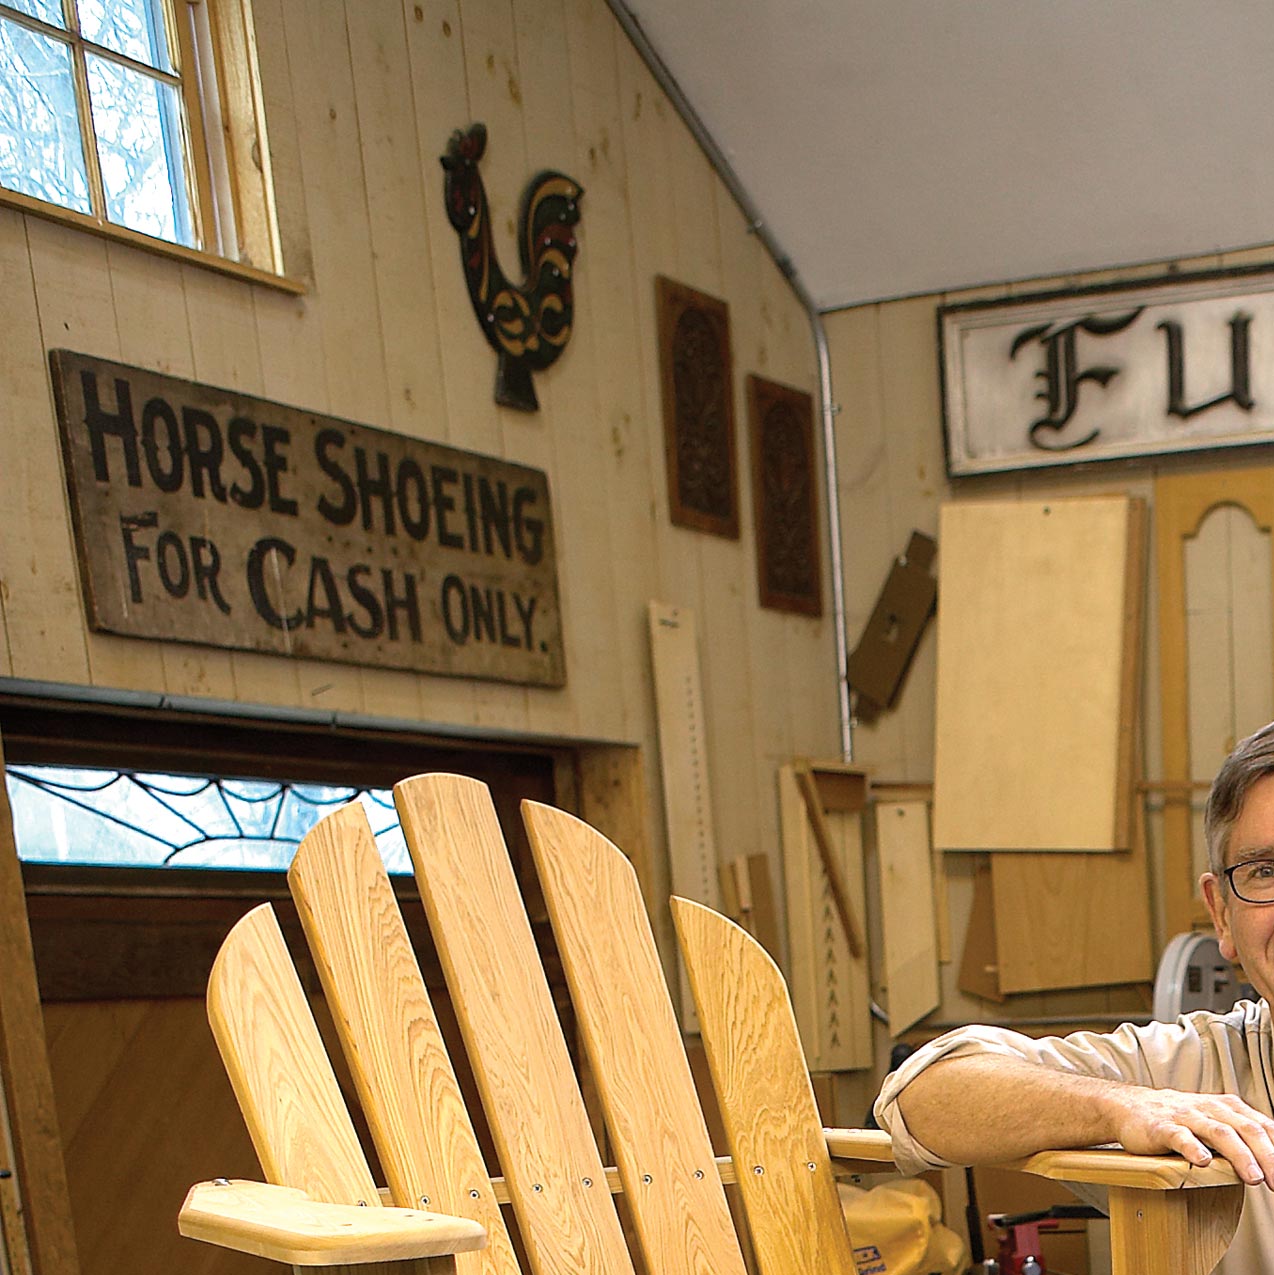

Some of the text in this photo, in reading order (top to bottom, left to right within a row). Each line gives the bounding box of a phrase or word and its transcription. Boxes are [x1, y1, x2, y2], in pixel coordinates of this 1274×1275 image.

[80, 370, 545, 566] HORSE SHOEING
[119, 511, 548, 653] FOR CASH ONLY.
